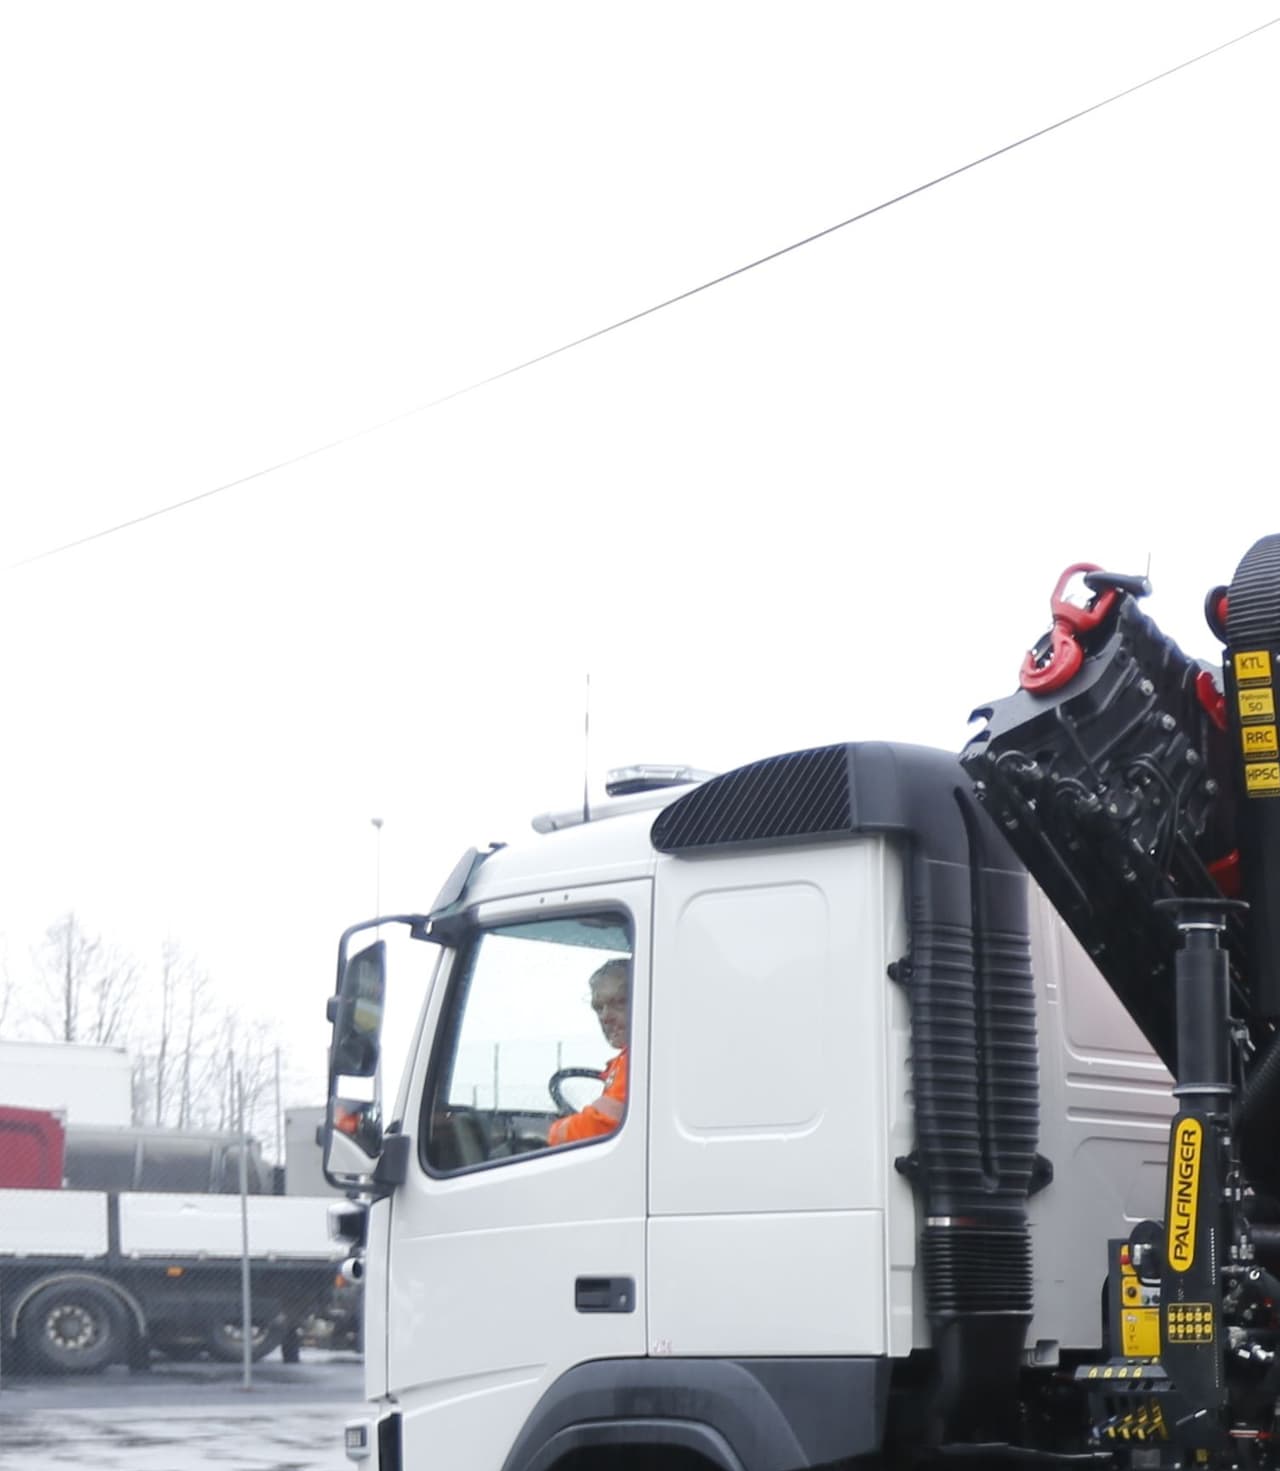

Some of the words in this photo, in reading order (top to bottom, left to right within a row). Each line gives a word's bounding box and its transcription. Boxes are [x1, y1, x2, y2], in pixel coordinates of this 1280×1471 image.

[1240, 656, 1265, 670] KTL
[1246, 730, 1273, 744] RRC
[1247, 767, 1279, 781] HPSC
[1173, 1129, 1197, 1261] PALFINGER
